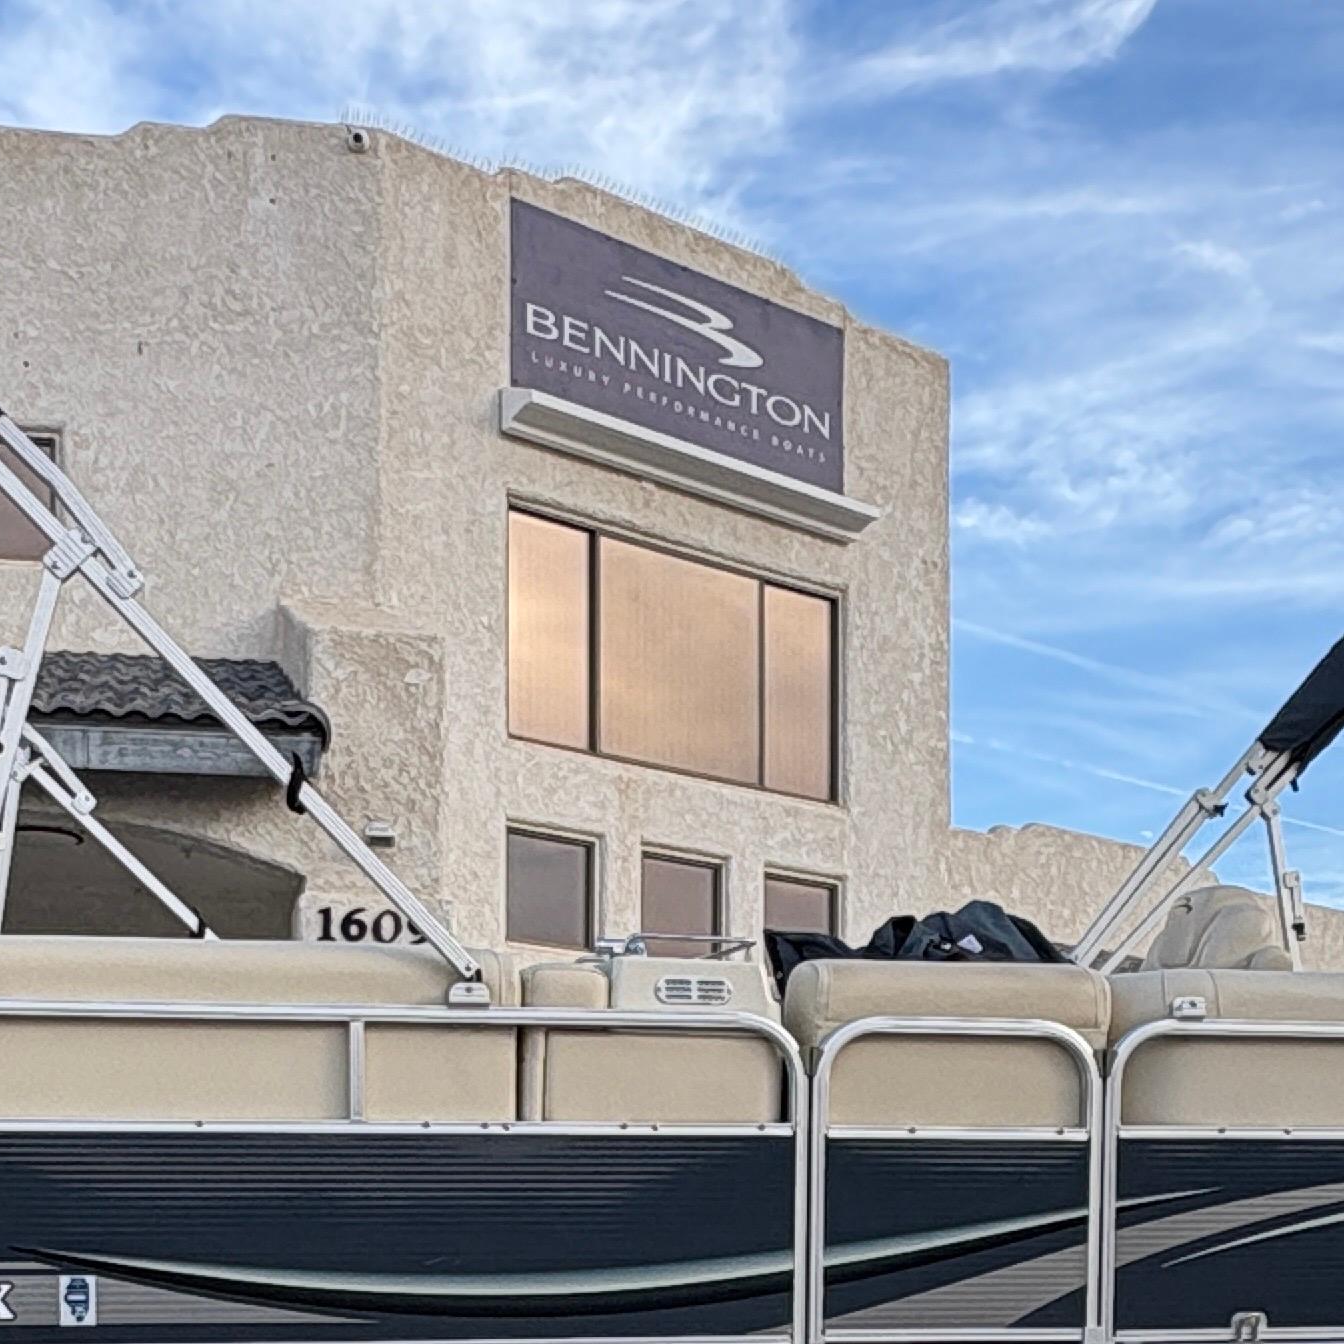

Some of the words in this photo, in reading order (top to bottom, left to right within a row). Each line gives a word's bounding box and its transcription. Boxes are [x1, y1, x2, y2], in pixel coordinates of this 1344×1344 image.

[525, 302, 830, 440] BENNINGTON
[531, 350, 610, 386] LUXURY
[623, 382, 760, 440] PERFORMANCE
[771, 434, 826, 464] BOATS
